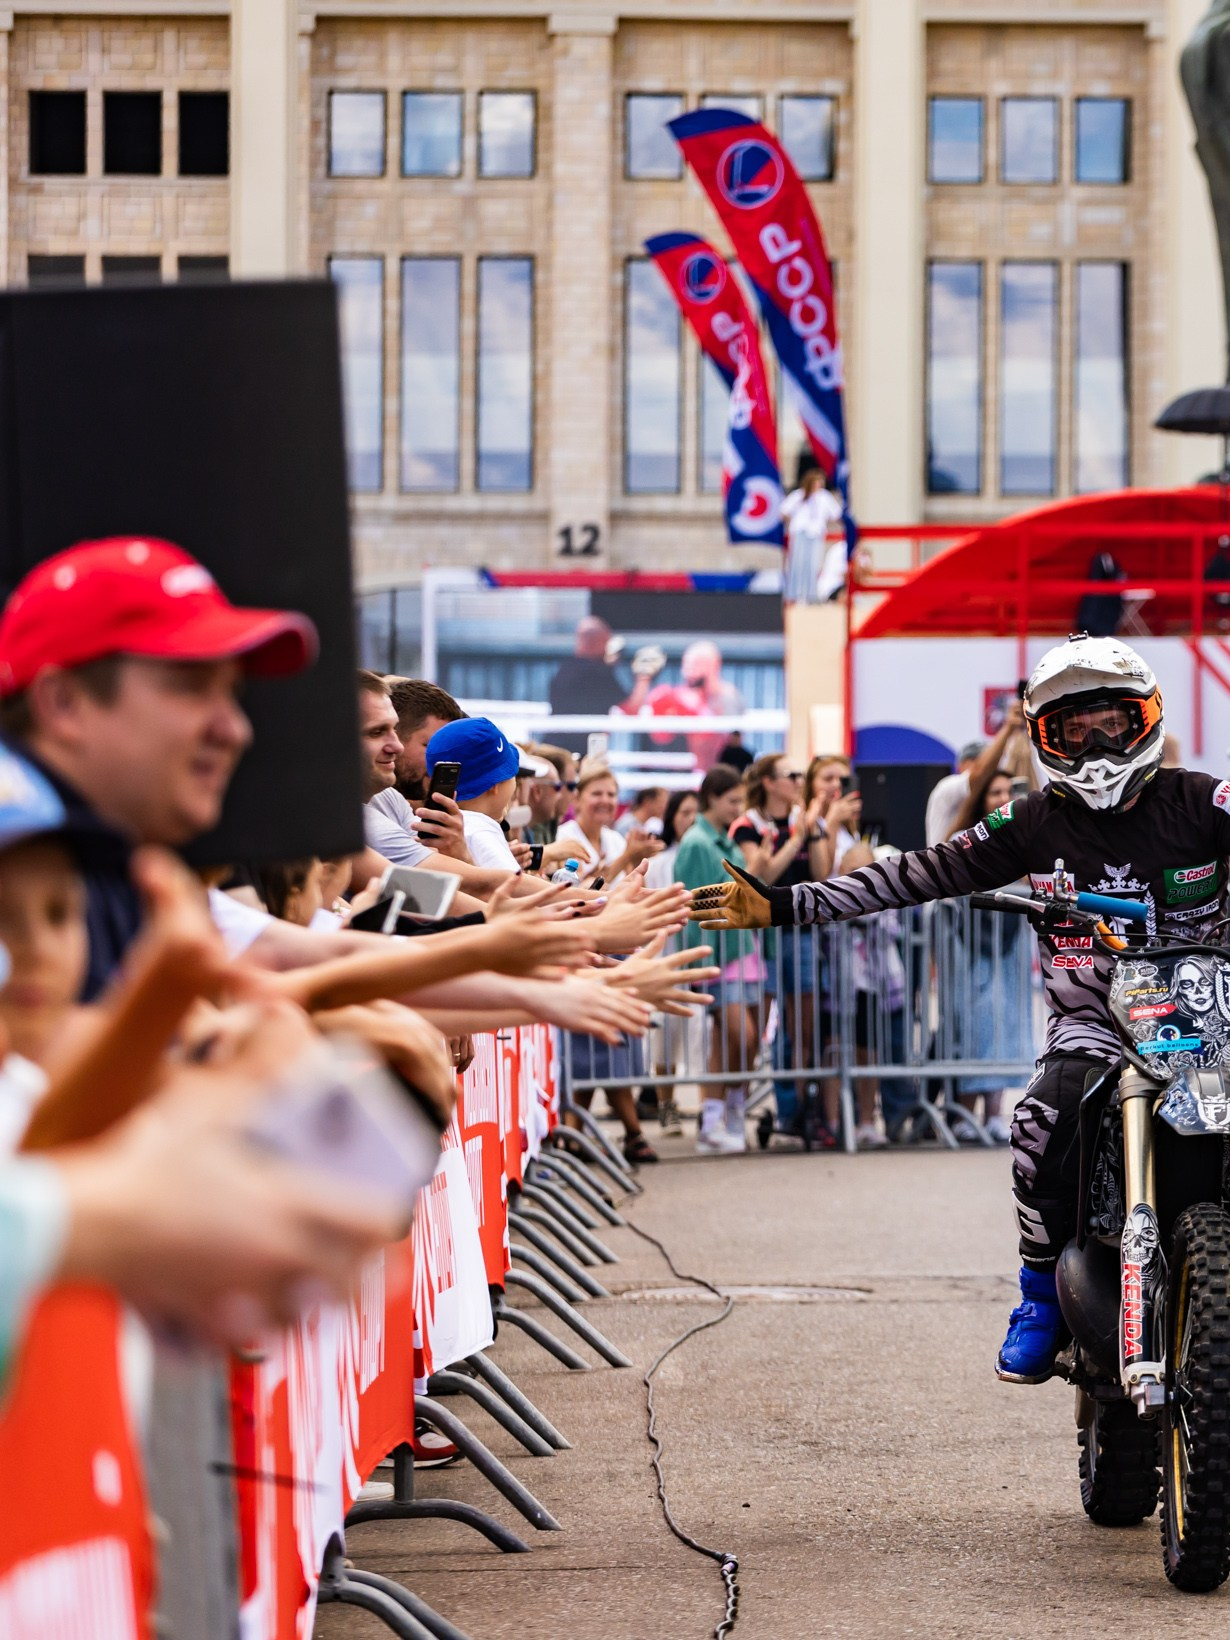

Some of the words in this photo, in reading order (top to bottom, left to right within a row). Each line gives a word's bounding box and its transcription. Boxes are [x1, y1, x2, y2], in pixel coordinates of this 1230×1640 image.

[558, 524, 600, 557] 12
[1186, 863, 1215, 881] Castrol
[1133, 1007, 1168, 1017] SENA
[1124, 1263, 1142, 1358] KENDA
